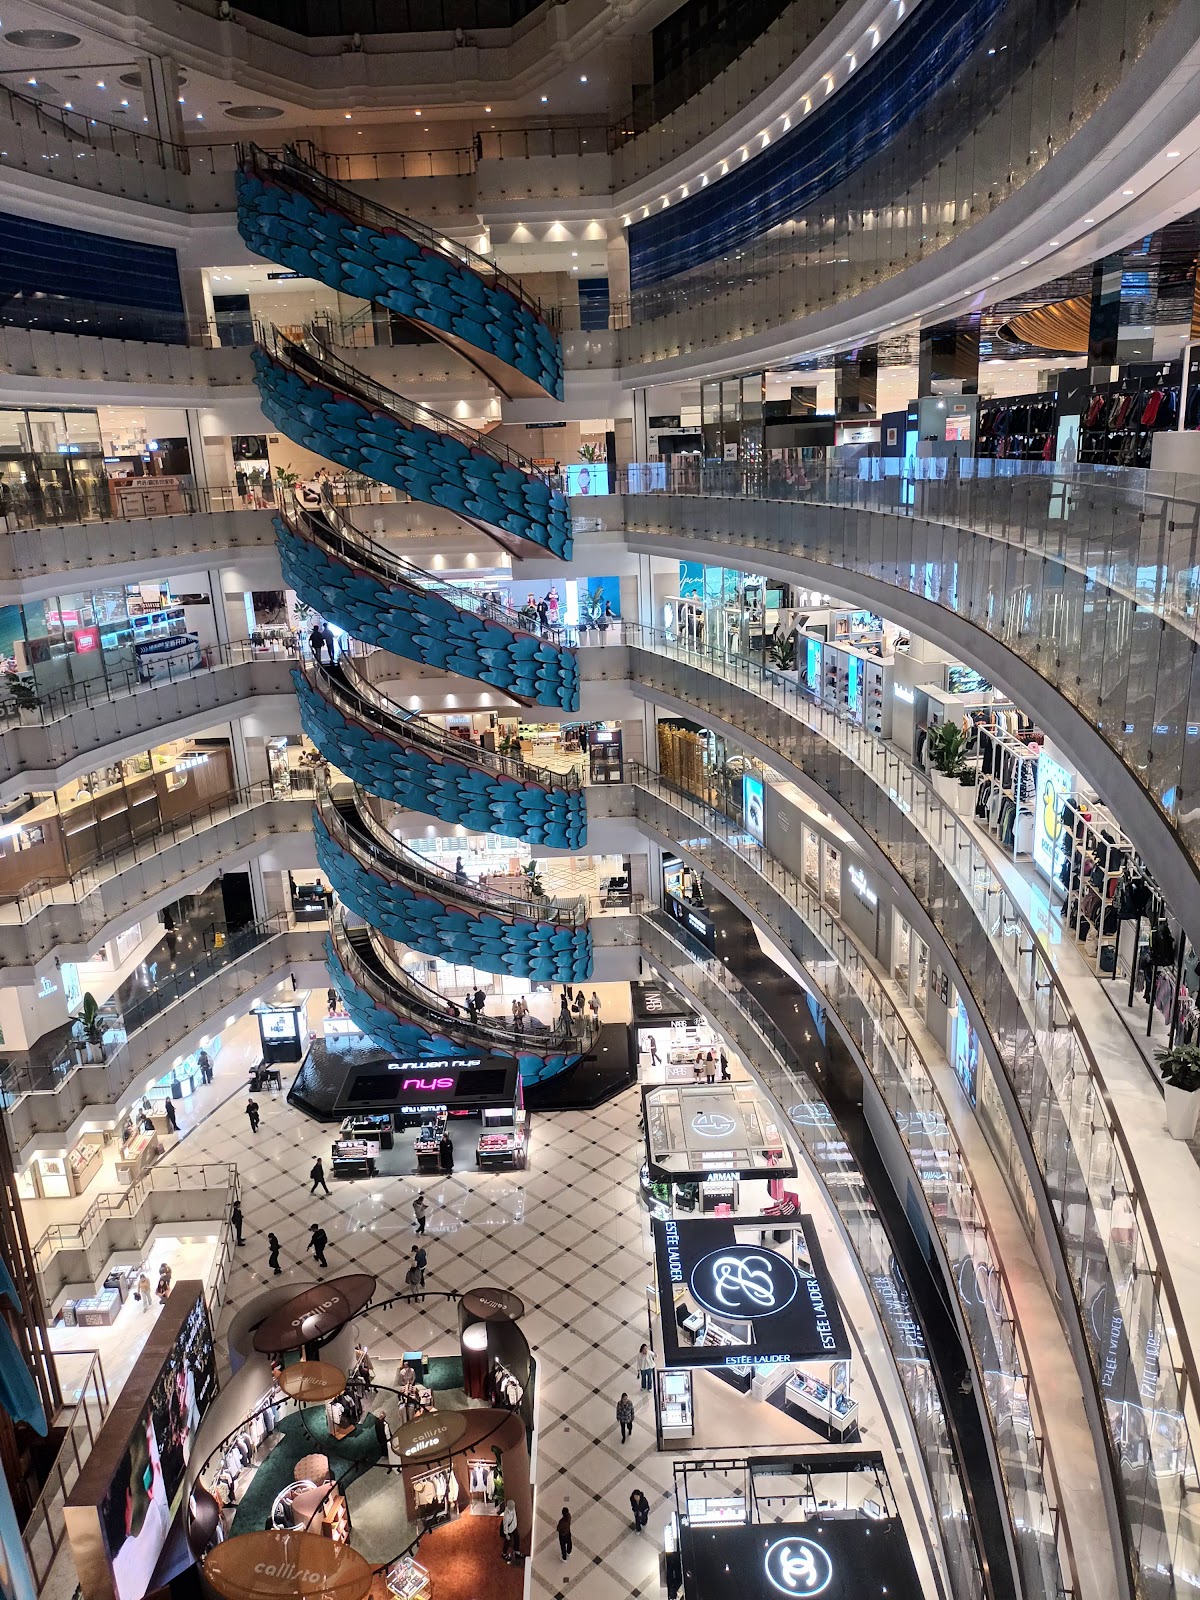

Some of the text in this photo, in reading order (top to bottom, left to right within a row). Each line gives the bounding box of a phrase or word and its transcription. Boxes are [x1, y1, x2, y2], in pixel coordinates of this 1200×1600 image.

[645, 993, 662, 1011] NARS
[402, 1077, 454, 1091] shu
[707, 1172, 740, 1181] ARMANI
[668, 1247, 683, 1281] LAUDER
[807, 1279, 827, 1318] LAUDER
[754, 1354, 791, 1363] LAUDER
[412, 1426, 448, 1443] callisto
[405, 1437, 440, 1457] callisto
[254, 1562, 321, 1584] callisto
